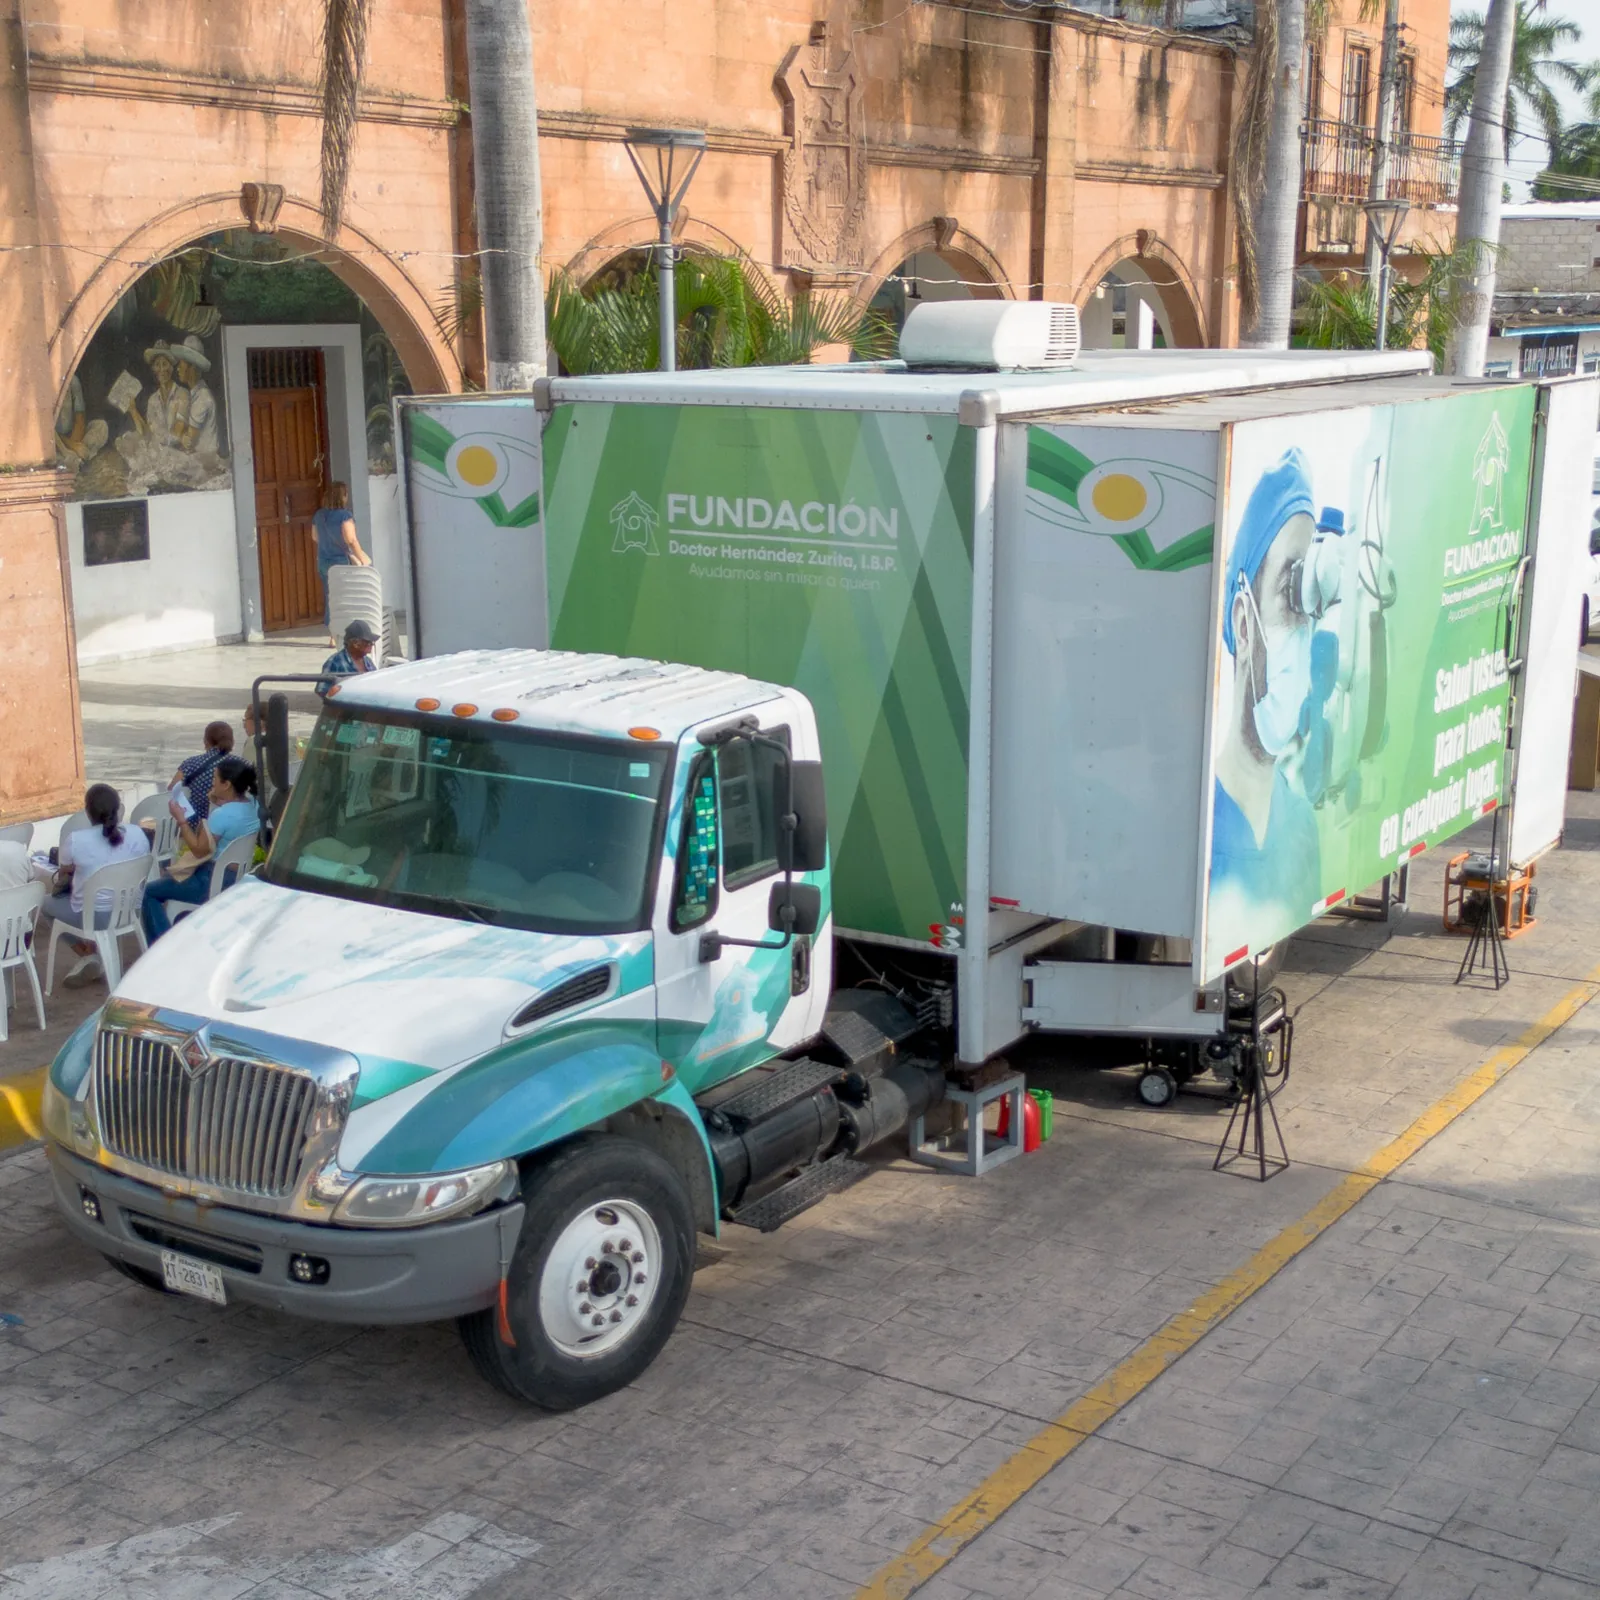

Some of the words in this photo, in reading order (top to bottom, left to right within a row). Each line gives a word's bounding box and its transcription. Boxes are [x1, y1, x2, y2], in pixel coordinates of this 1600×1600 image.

[1546, 345, 1574, 370] PLANET
[667, 493, 898, 540] FUNDACIÓN
[669, 540, 718, 557] Doctor
[721, 545, 805, 564] Hernández
[808, 550, 857, 571] Zurita,
[861, 554, 898, 572] I.B.P.
[689, 563, 761, 581] Ayudamos
[764, 570, 783, 582] sin
[786, 572, 824, 587] mirar
[826, 576, 837, 588] a
[1443, 527, 1520, 577] FUNDACIÓN
[1434, 657, 1472, 713] Salud
[1434, 723, 1466, 777] para
[1467, 705, 1502, 754] todos,
[1380, 814, 1399, 858] en
[1402, 776, 1465, 846] cualquier
[1465, 760, 1499, 810] lugar.
[166, 1262, 220, 1292] XT-2831-A
